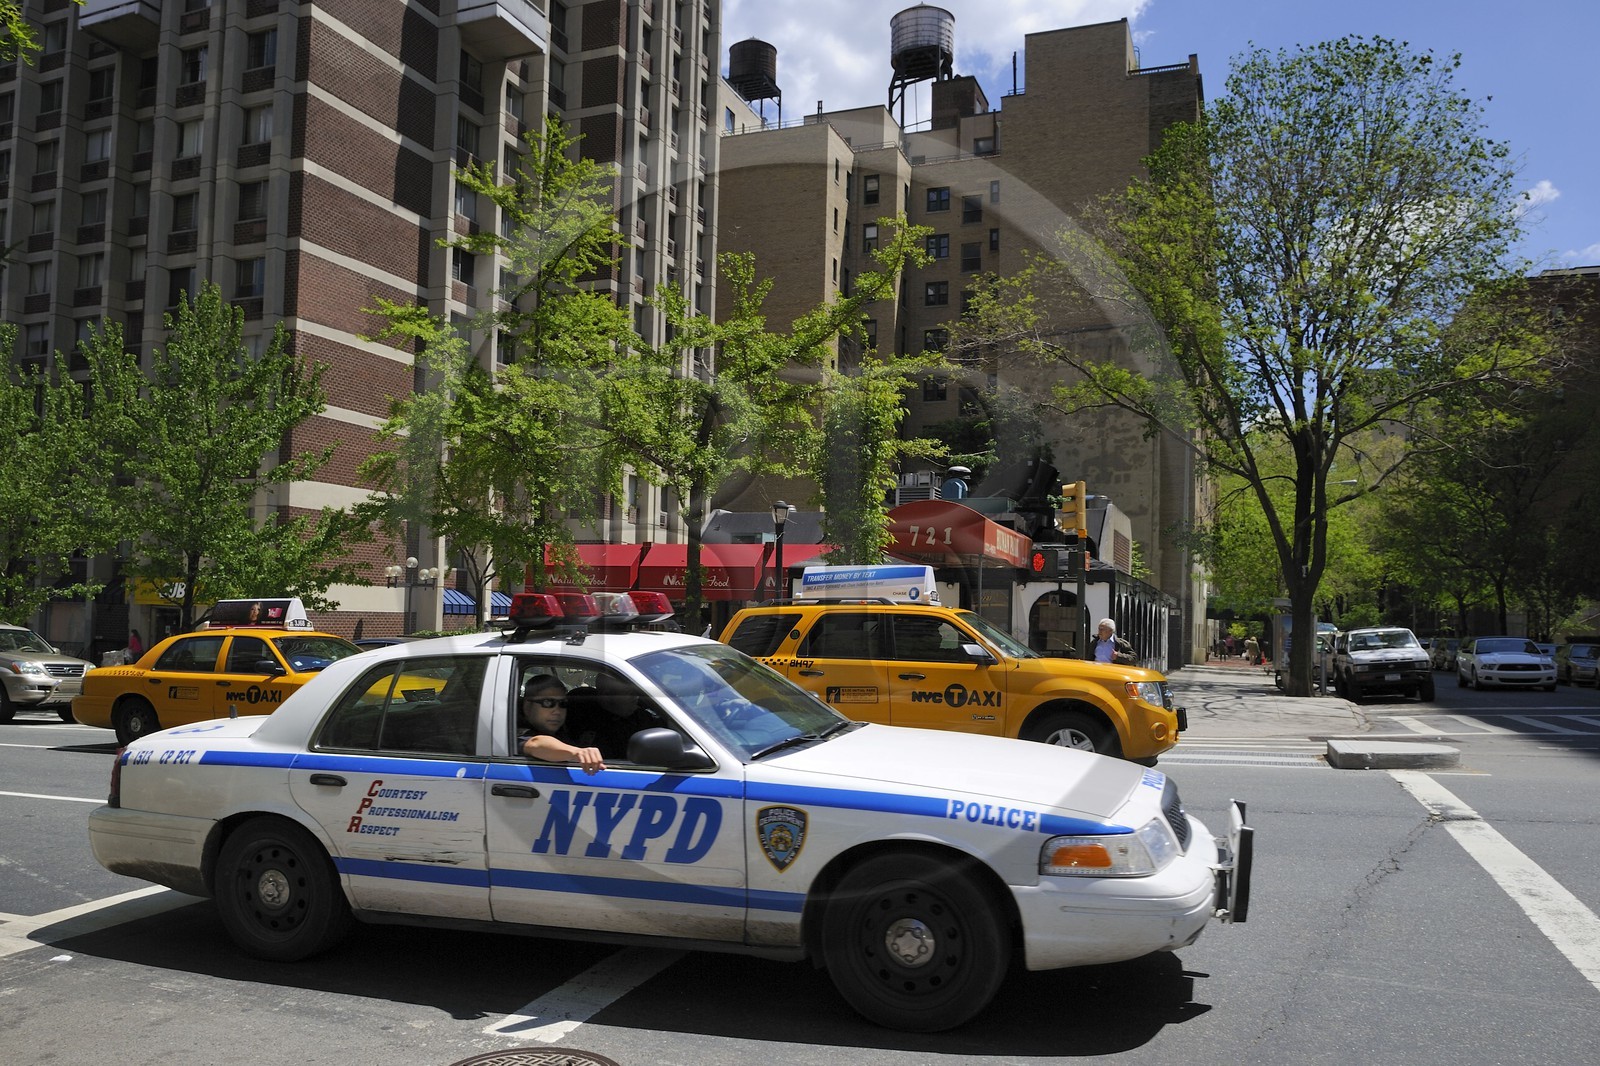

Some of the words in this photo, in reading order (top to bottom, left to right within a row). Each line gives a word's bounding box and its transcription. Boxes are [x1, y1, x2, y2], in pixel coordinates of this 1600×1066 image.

[909, 525, 952, 546] 721
[587, 574, 608, 585] Food
[708, 575, 730, 587] Food
[807, 573, 833, 582] TRANSFER
[834, 572, 853, 580] MONEY
[853, 571, 861, 579] BY
[226, 691, 246, 701] NYC
[246, 685, 282, 704] TAXI
[912, 690, 943, 704] NYC
[944, 683, 1002, 708] TAXI
[133, 750, 154, 765] 1513
[160, 750, 175, 764] CP
[173, 750, 197, 764] PCT
[367, 780, 428, 800] COURTESY
[356, 798, 460, 821] PROFESSIONALISM
[768, 808, 797, 818] POLICE
[950, 799, 1036, 832] POLICE
[347, 816, 400, 836] RESPECT
[531, 790, 723, 864] NYPD
[759, 815, 805, 828] DEPARTMENT
